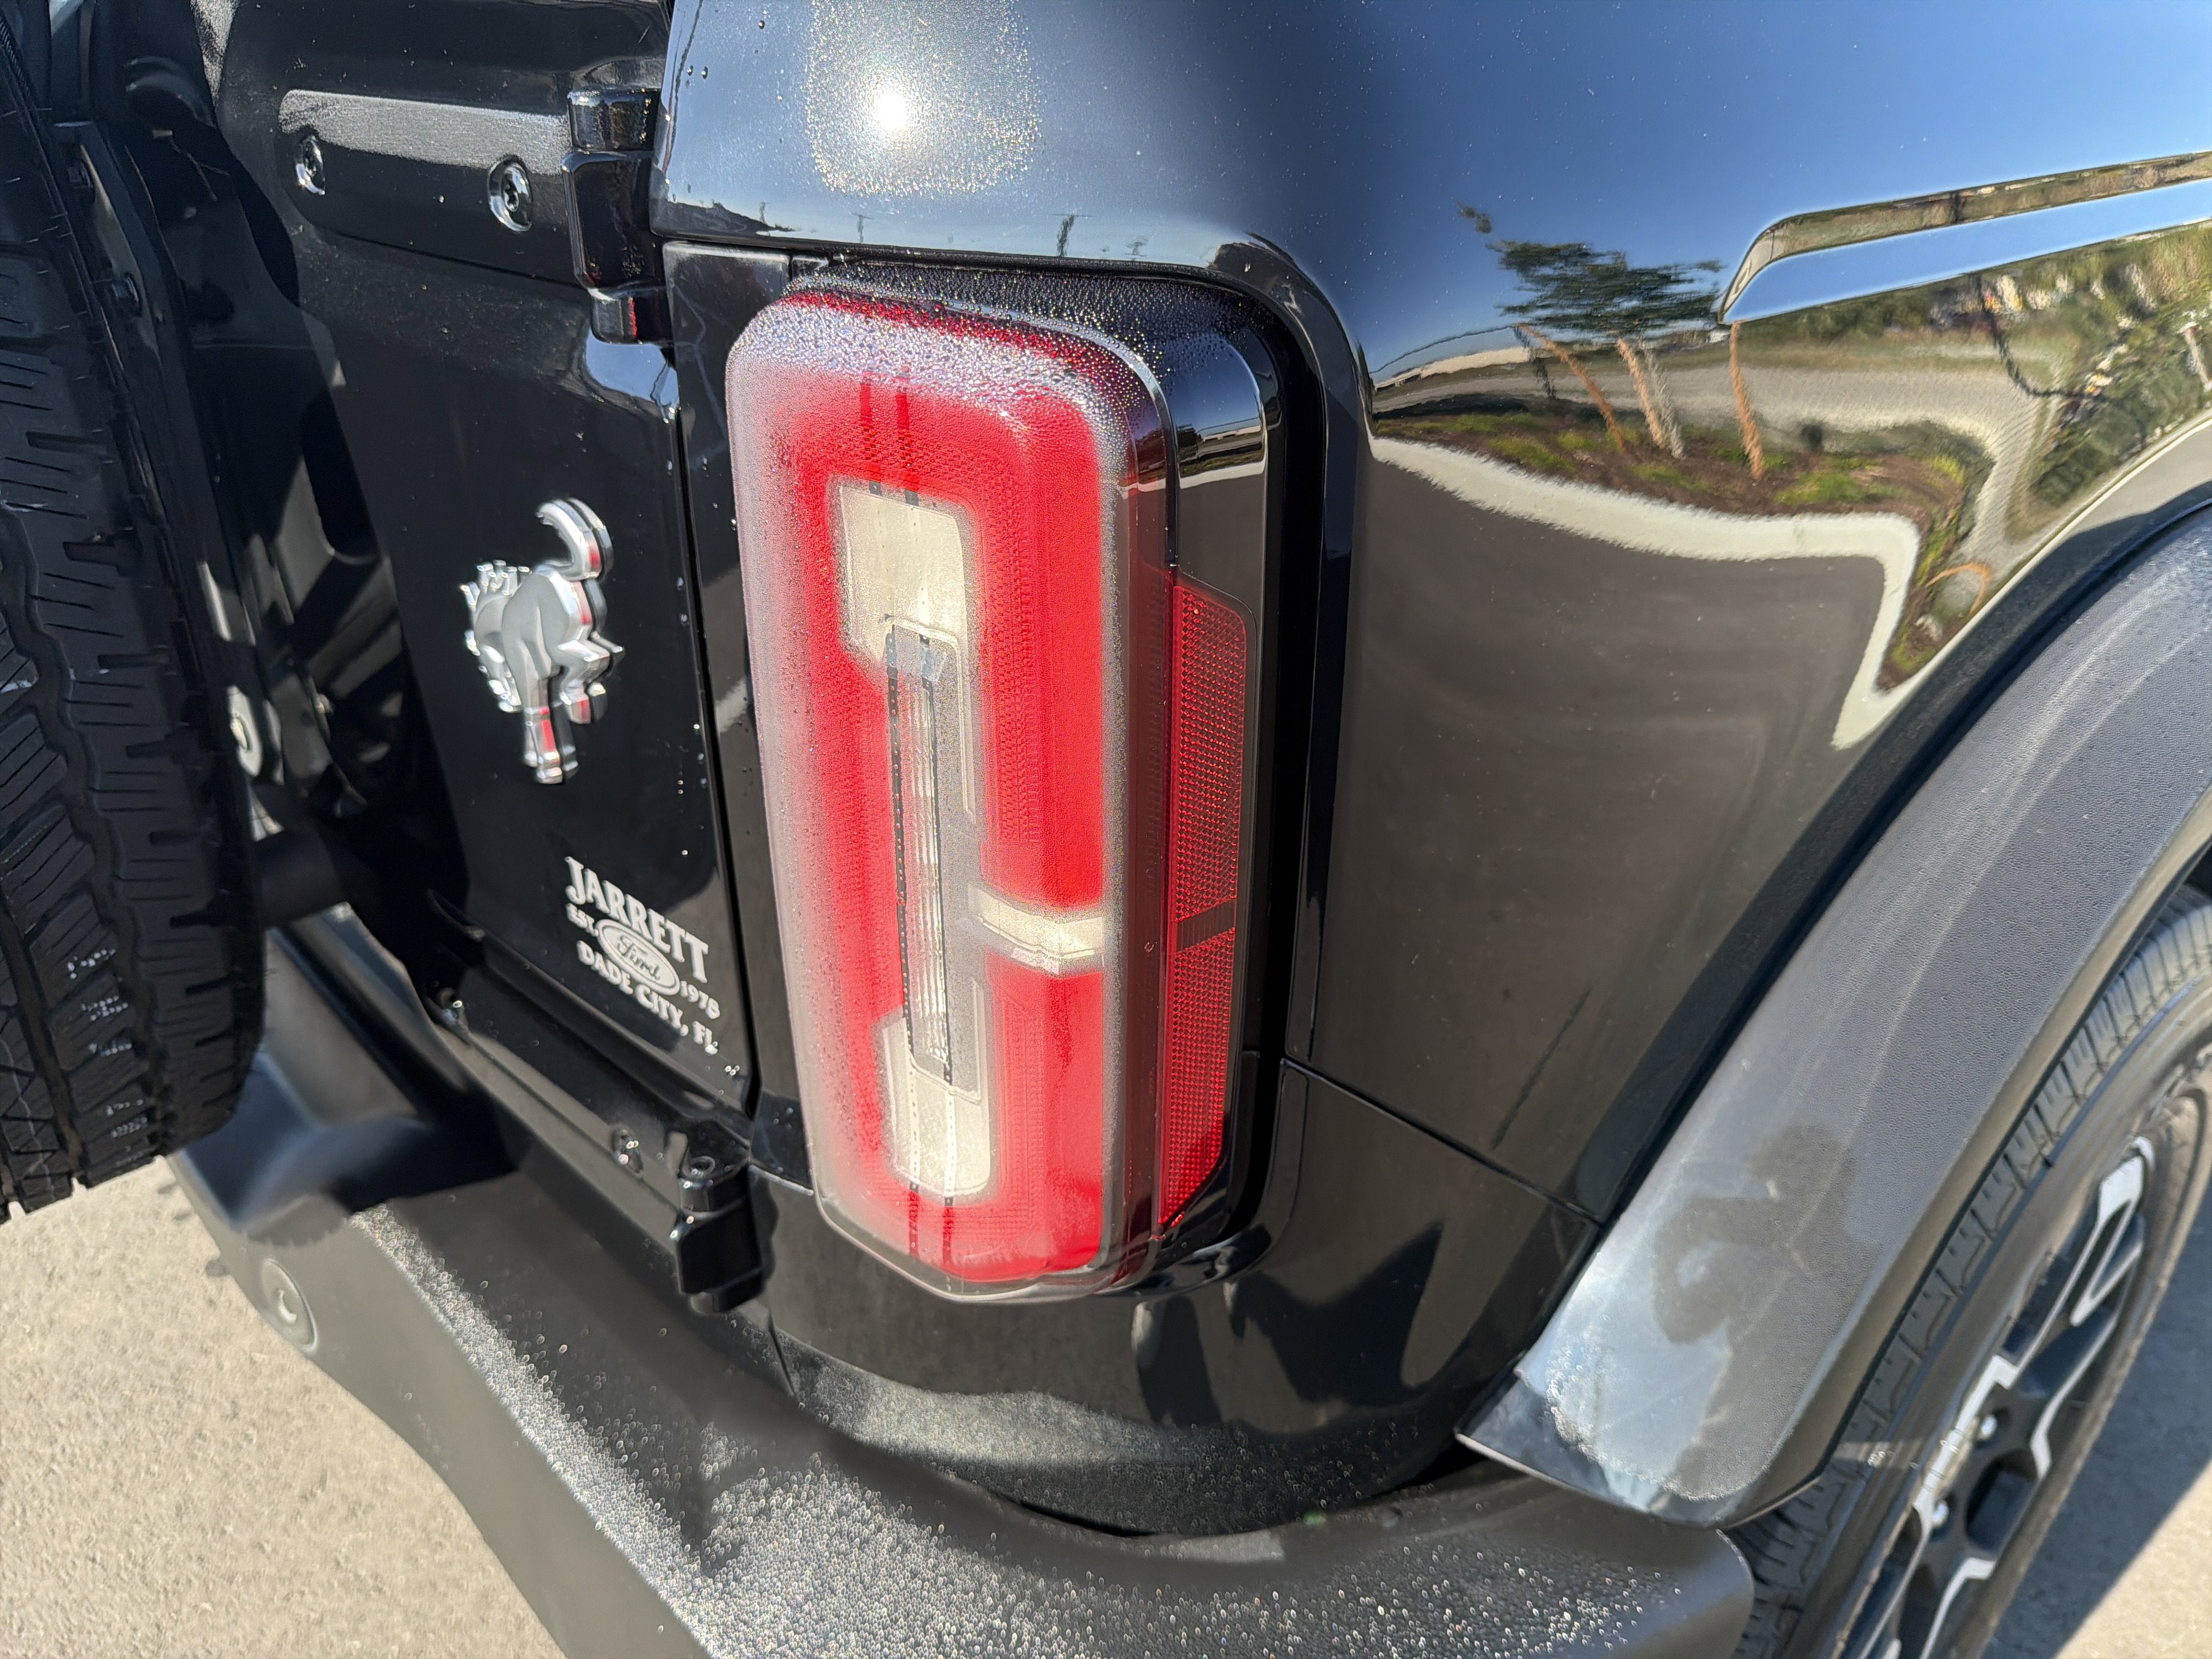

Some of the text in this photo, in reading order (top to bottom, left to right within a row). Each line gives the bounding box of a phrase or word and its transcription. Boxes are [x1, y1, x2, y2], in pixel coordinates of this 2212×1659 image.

[565, 856, 709, 984] JARRETT
[566, 902, 720, 1019] EST. 1978
[617, 935, 662, 981] Ford
[576, 940, 634, 995] DADE
